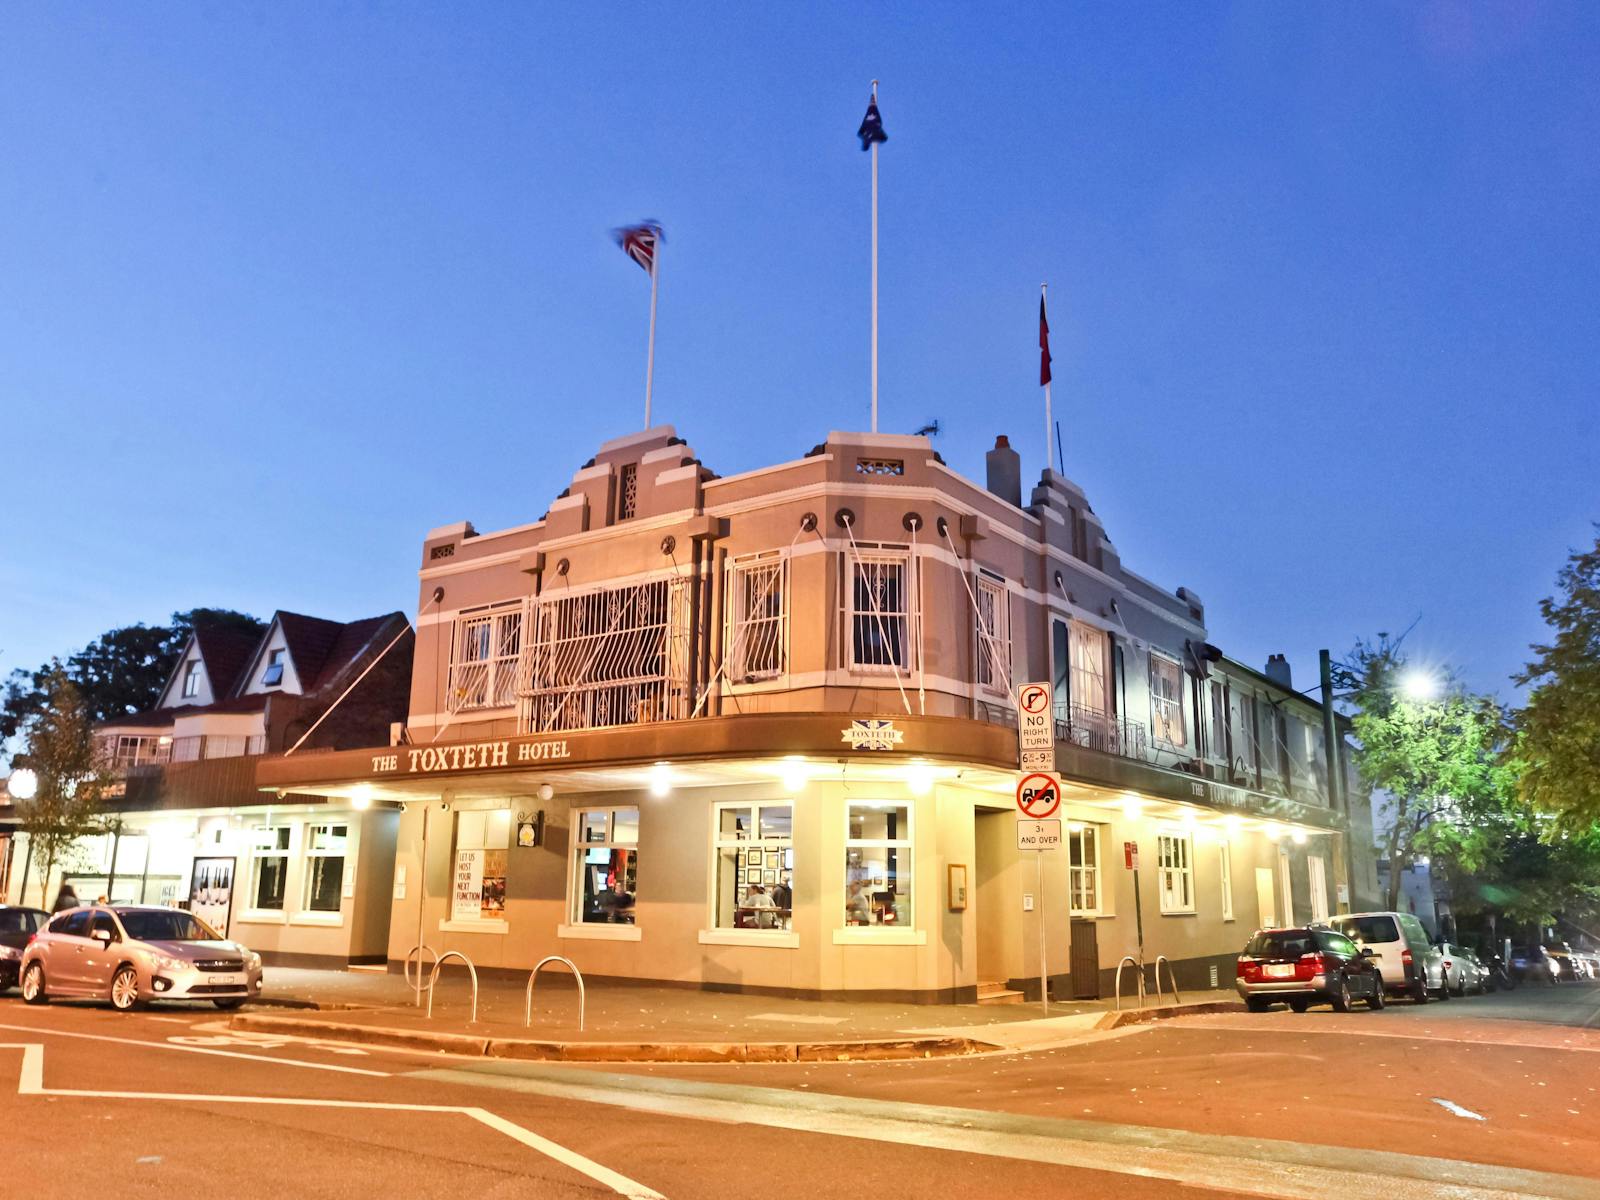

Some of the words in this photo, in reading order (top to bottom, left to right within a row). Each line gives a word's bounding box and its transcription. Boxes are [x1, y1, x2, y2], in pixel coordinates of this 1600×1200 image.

[1027, 716, 1044, 726] NO
[1023, 728, 1049, 736] RIGHT
[1025, 738, 1049, 746] TURN
[372, 755, 398, 772] THE
[408, 741, 509, 772] TOXTETH
[517, 741, 571, 761] HOTEL
[1191, 782, 1205, 797] THE
[1021, 836, 1036, 844] AND
[1039, 836, 1058, 844] OVER
[459, 853, 468, 862] LET
[469, 852, 475, 861] US
[459, 863, 471, 871] HOST
[458, 872, 471, 881] YOUR
[457, 882, 470, 891] NEXT
[456, 892, 480, 901] FUNCTION
